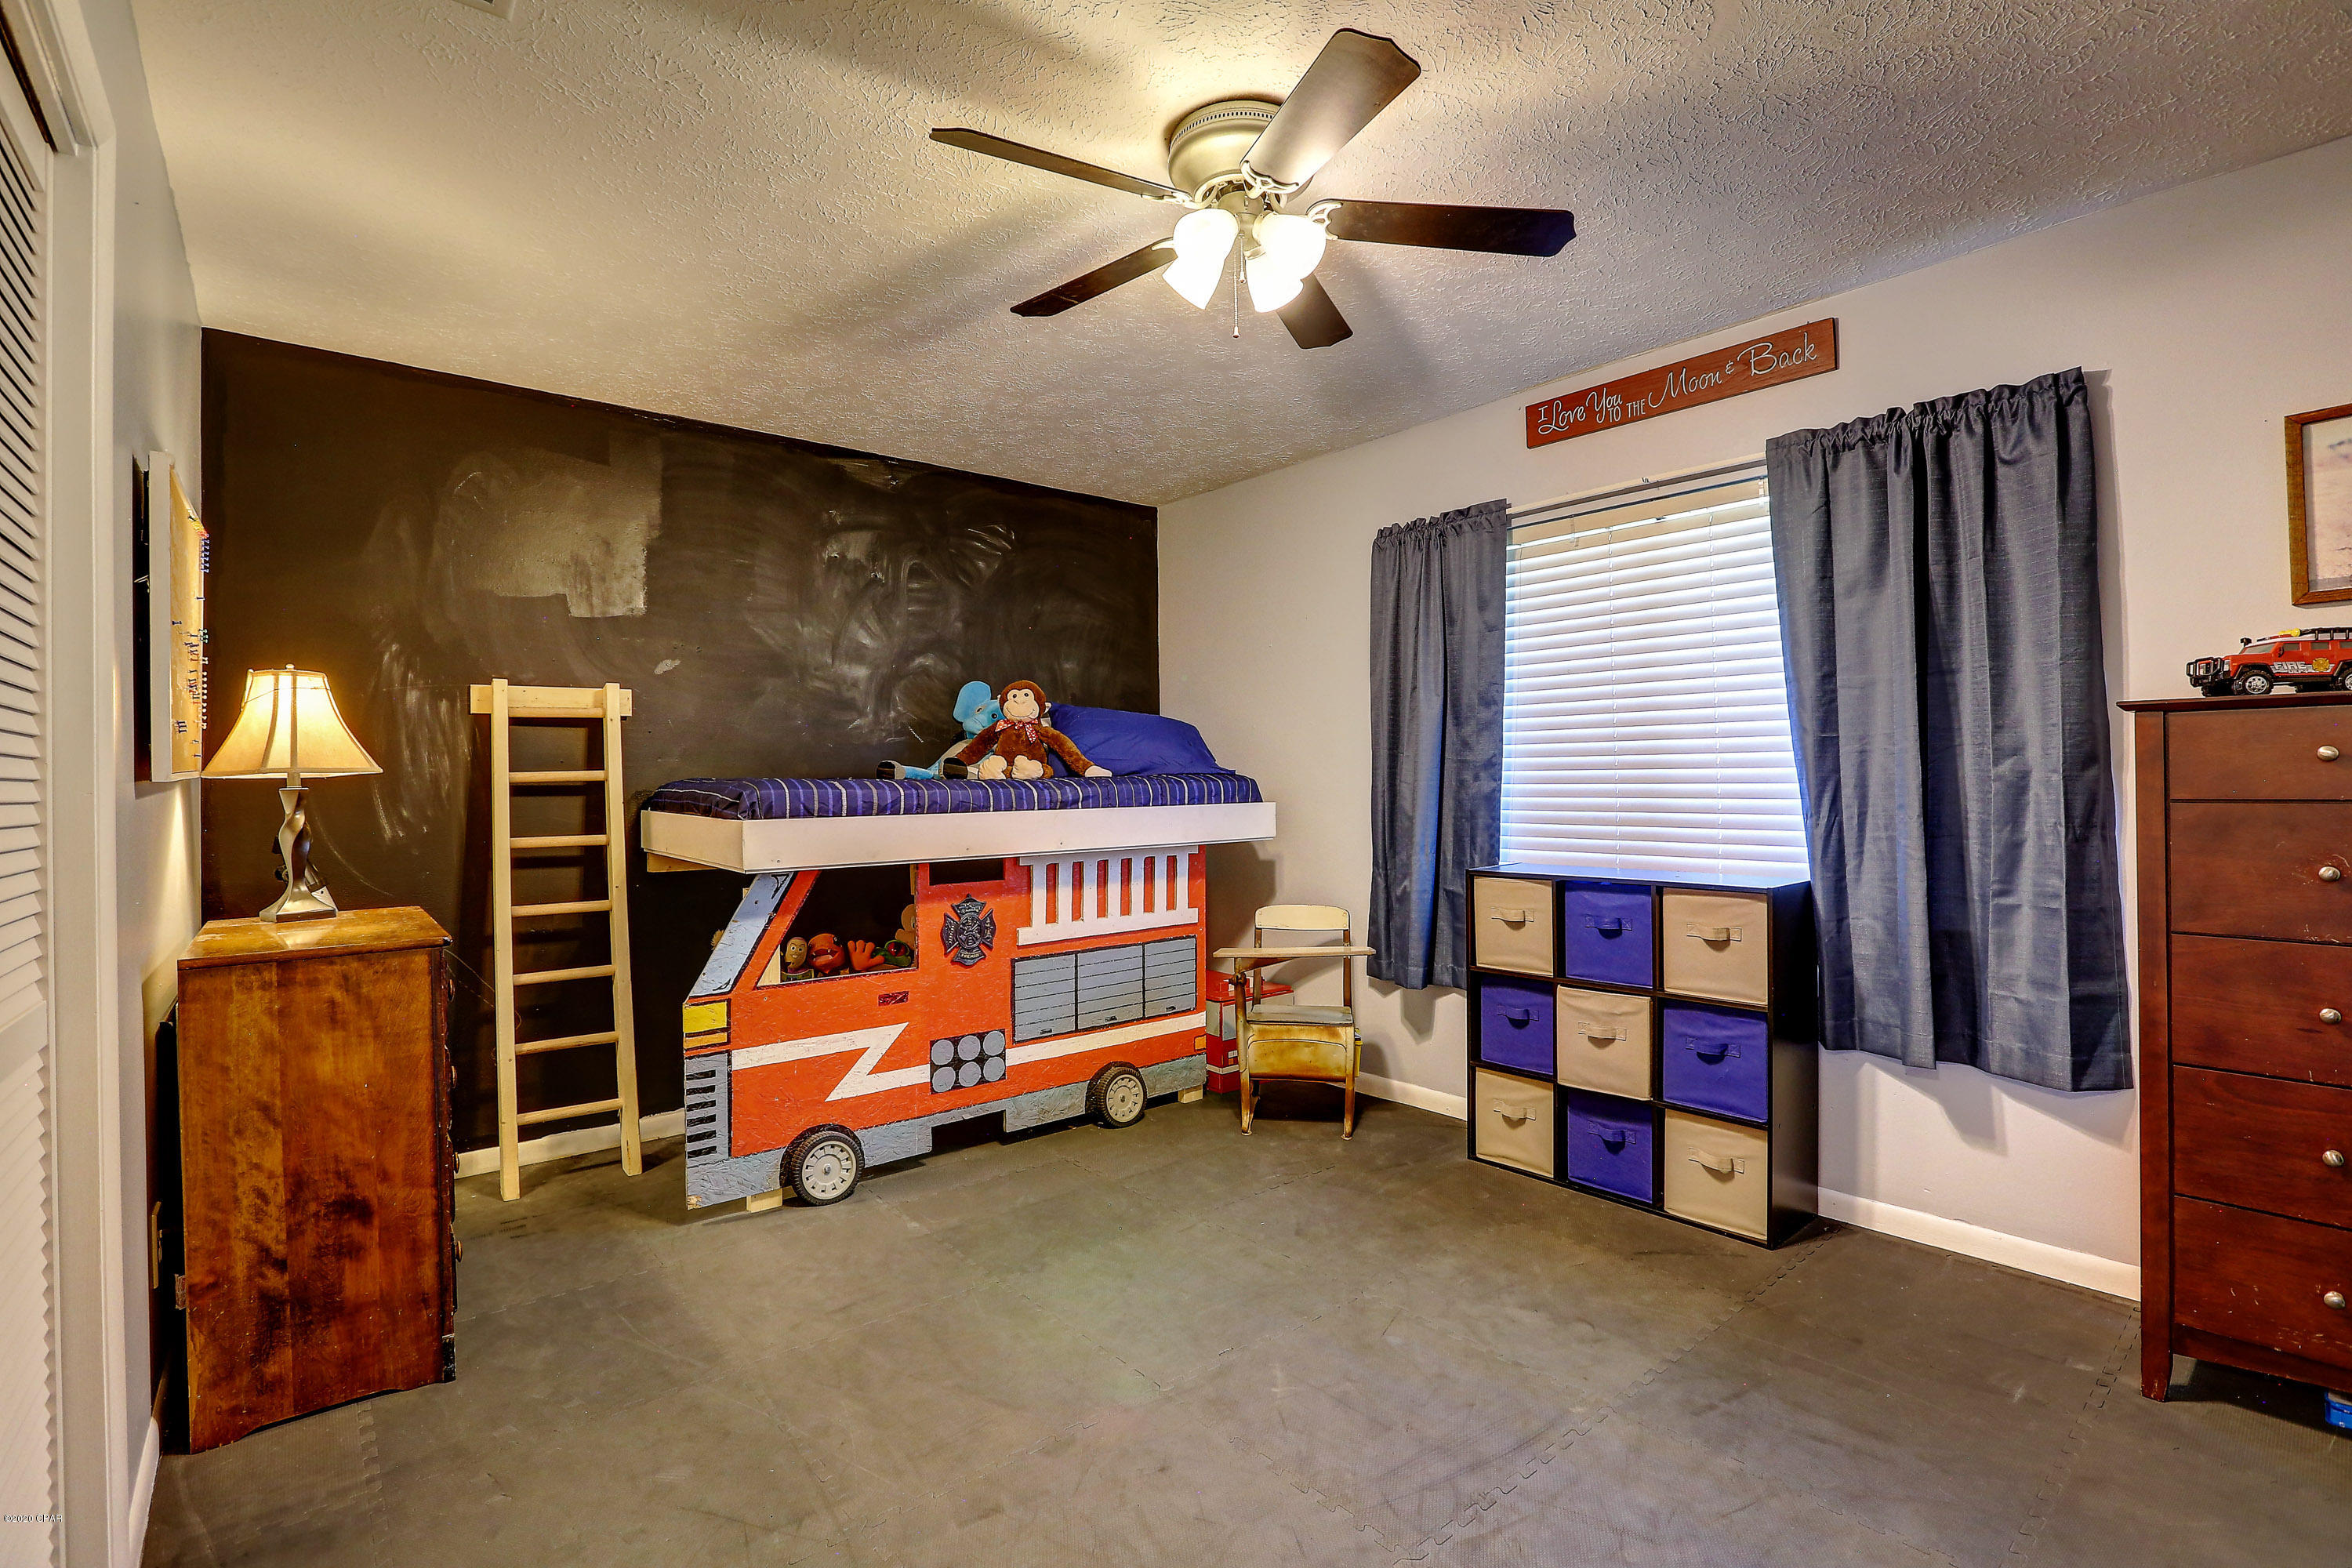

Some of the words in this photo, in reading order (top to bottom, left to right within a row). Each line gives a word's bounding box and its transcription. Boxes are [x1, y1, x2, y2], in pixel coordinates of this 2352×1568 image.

[1737, 332, 1817, 376] Back
[1725, 360, 1736, 375] &
[1647, 367, 1723, 408] Moon
[1537, 405, 1548, 423] I
[1585, 387, 1623, 423] You
[1607, 405, 1621, 423] TO
[1625, 398, 1646, 418] THE
[1537, 400, 1586, 434] Love
[2274, 662, 2307, 670] FIRE
